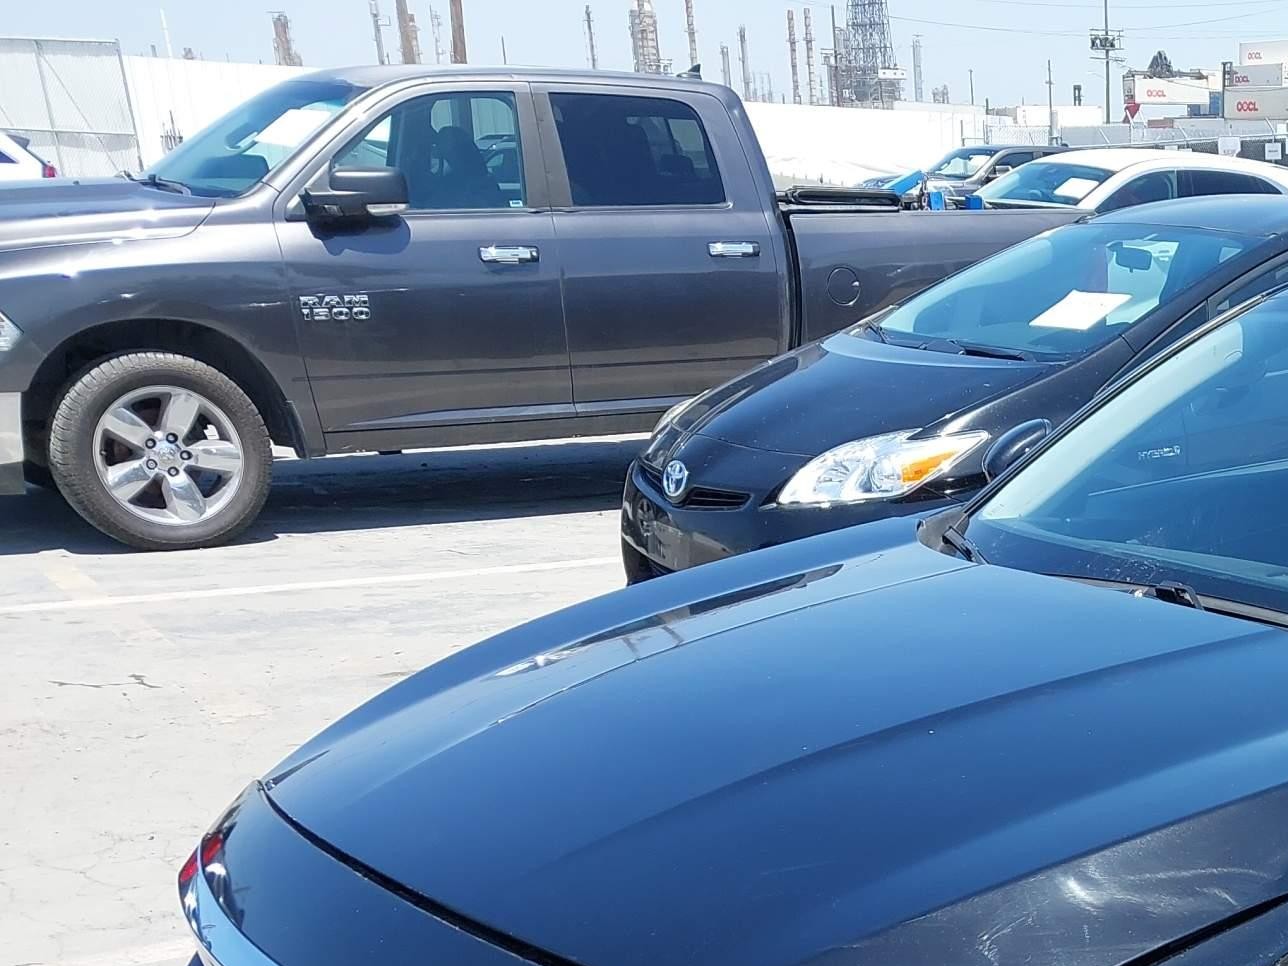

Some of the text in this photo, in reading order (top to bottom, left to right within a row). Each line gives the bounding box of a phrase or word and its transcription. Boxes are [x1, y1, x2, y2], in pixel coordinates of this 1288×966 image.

[1146, 89, 1167, 98] OOCL
[1236, 100, 1259, 112] OOCL
[299, 294, 369, 307] RAM
[301, 307, 371, 321] 1500
